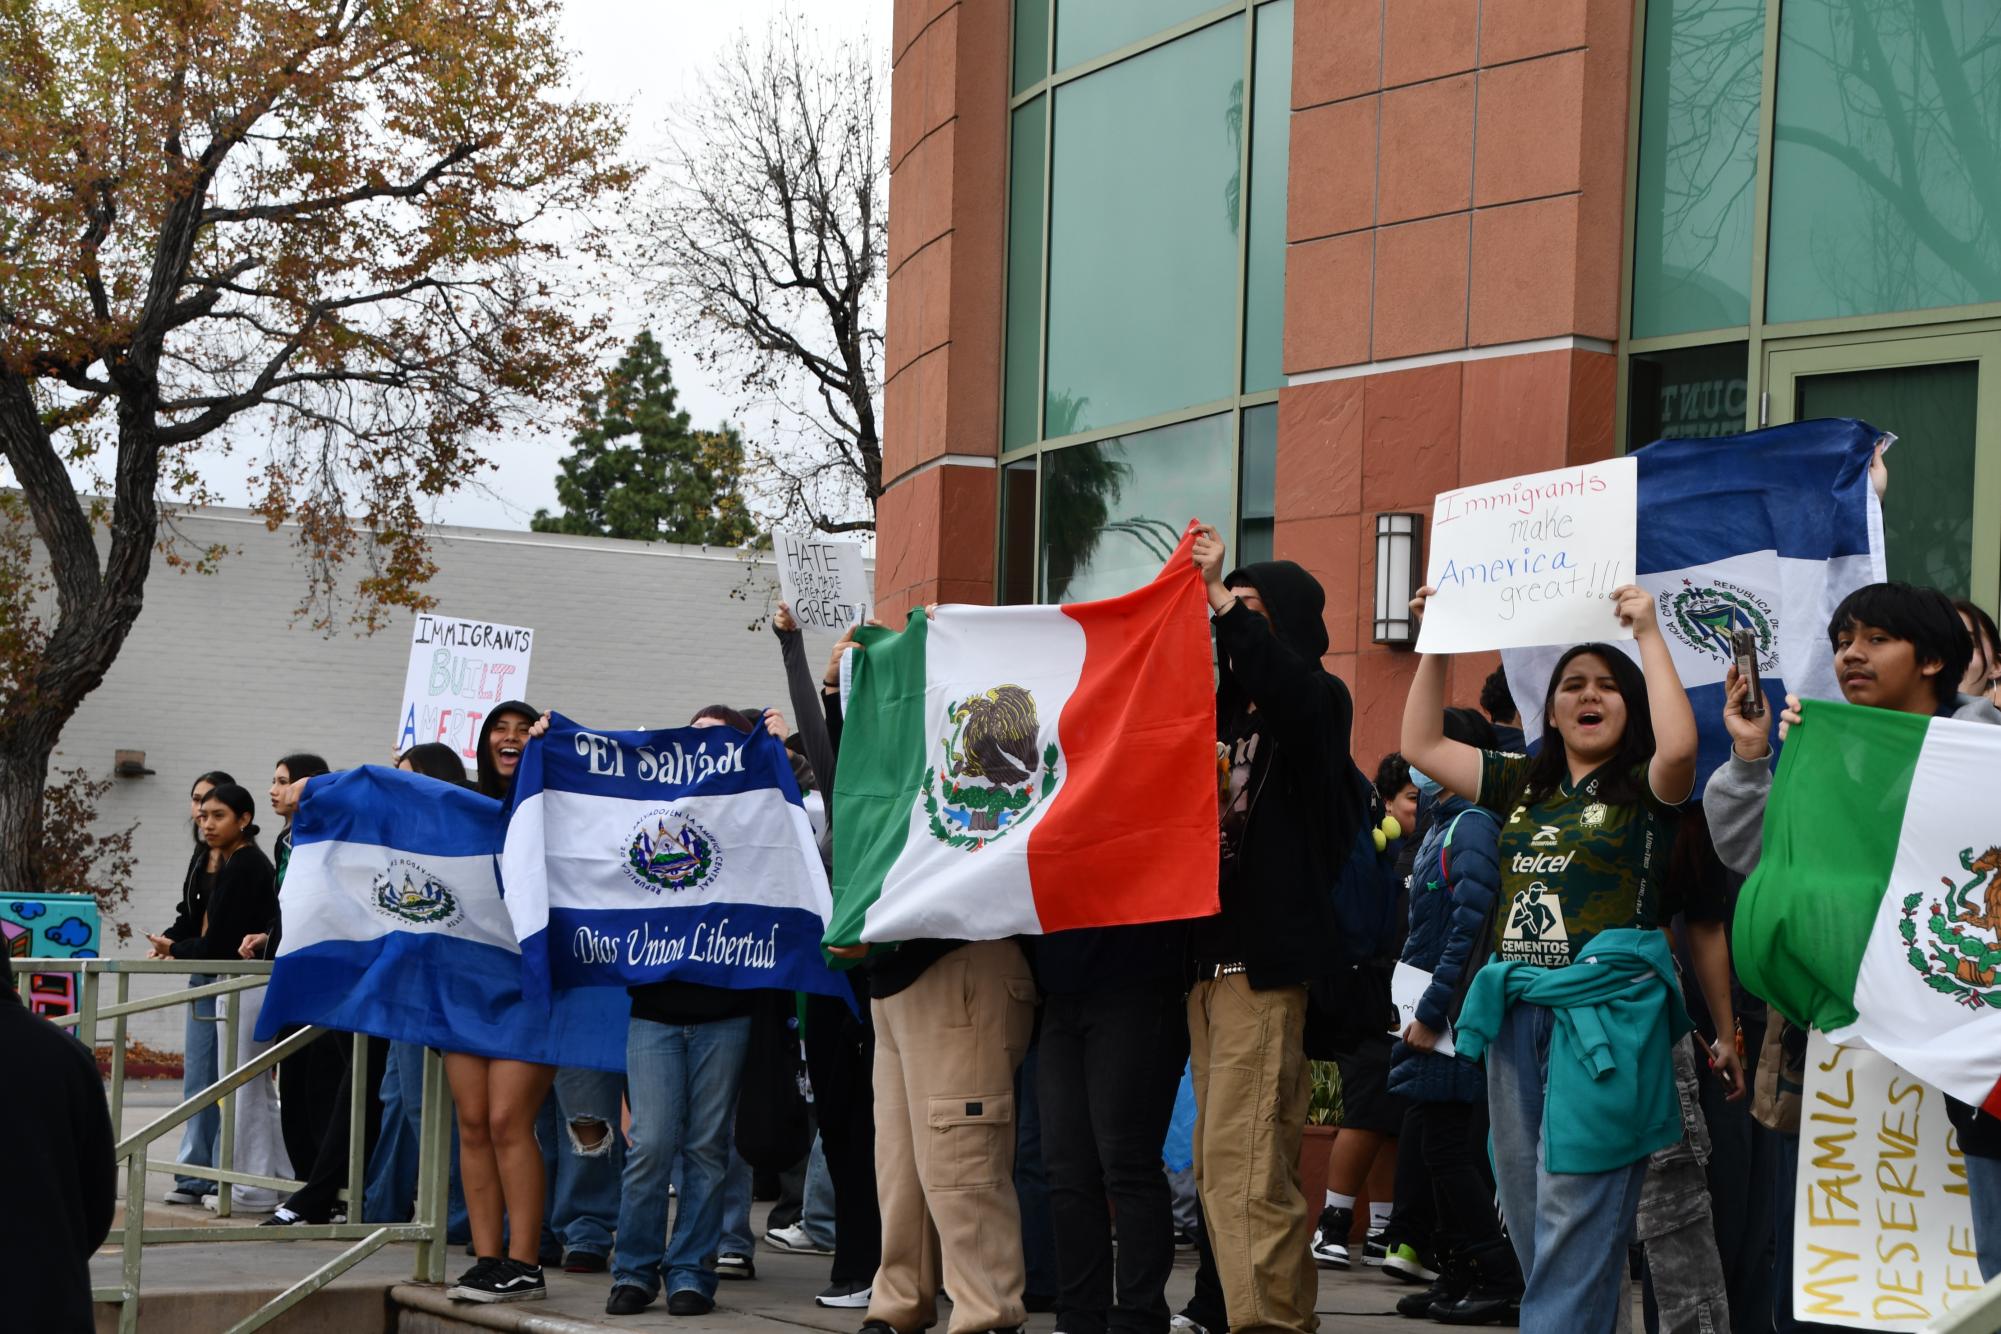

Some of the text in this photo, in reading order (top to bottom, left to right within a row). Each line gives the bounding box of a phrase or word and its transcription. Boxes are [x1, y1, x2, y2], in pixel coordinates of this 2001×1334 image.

[1436, 469, 1607, 526] Immigrants
[1510, 506, 1574, 543] make
[785, 536, 840, 573] HATE
[1435, 547, 1578, 592] America
[788, 569, 842, 590] NEVER MADE
[798, 586, 840, 600] AMERICA
[1713, 579, 1772, 615] REPUBLICA
[796, 598, 851, 629] GREAT
[415, 617, 530, 652] IMMIGRANTS
[1666, 622, 1706, 654] AMERICA
[428, 648, 516, 702] BUILT
[400, 702, 483, 758] AMERI
[575, 731, 625, 777] El
[1512, 850, 1576, 873] telcel
[573, 918, 779, 969] Dios Union Libertad
[1502, 940, 1570, 954] CEMENTOS
[1872, 1077, 1932, 1320] DESERVES
[1802, 1244, 1861, 1318] MY
[1942, 1225, 1984, 1313] EE
